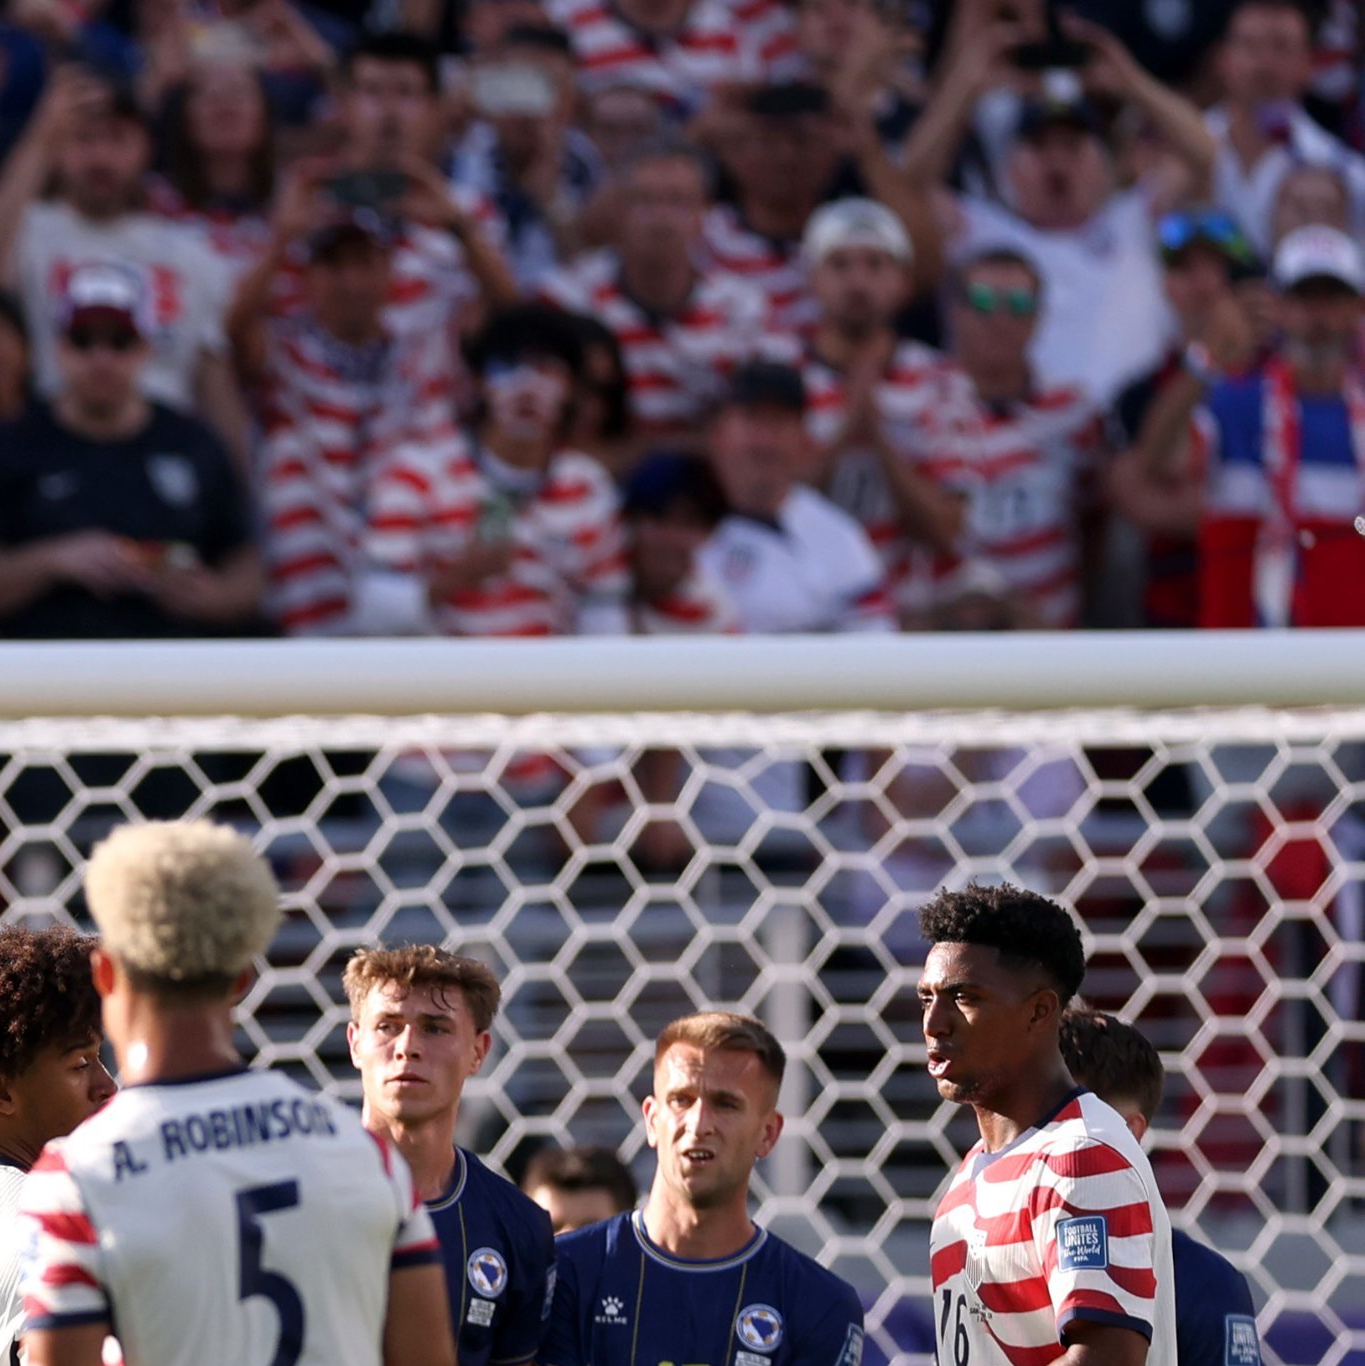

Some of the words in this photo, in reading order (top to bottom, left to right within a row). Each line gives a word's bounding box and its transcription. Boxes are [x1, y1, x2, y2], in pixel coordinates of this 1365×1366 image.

[112, 1140, 149, 1181] A.
[160, 1098, 337, 1162] ROBINSON
[1064, 1223, 1098, 1235] FOOTBALL
[1064, 1233, 1099, 1246] UNITES
[1076, 1244, 1102, 1257] World
